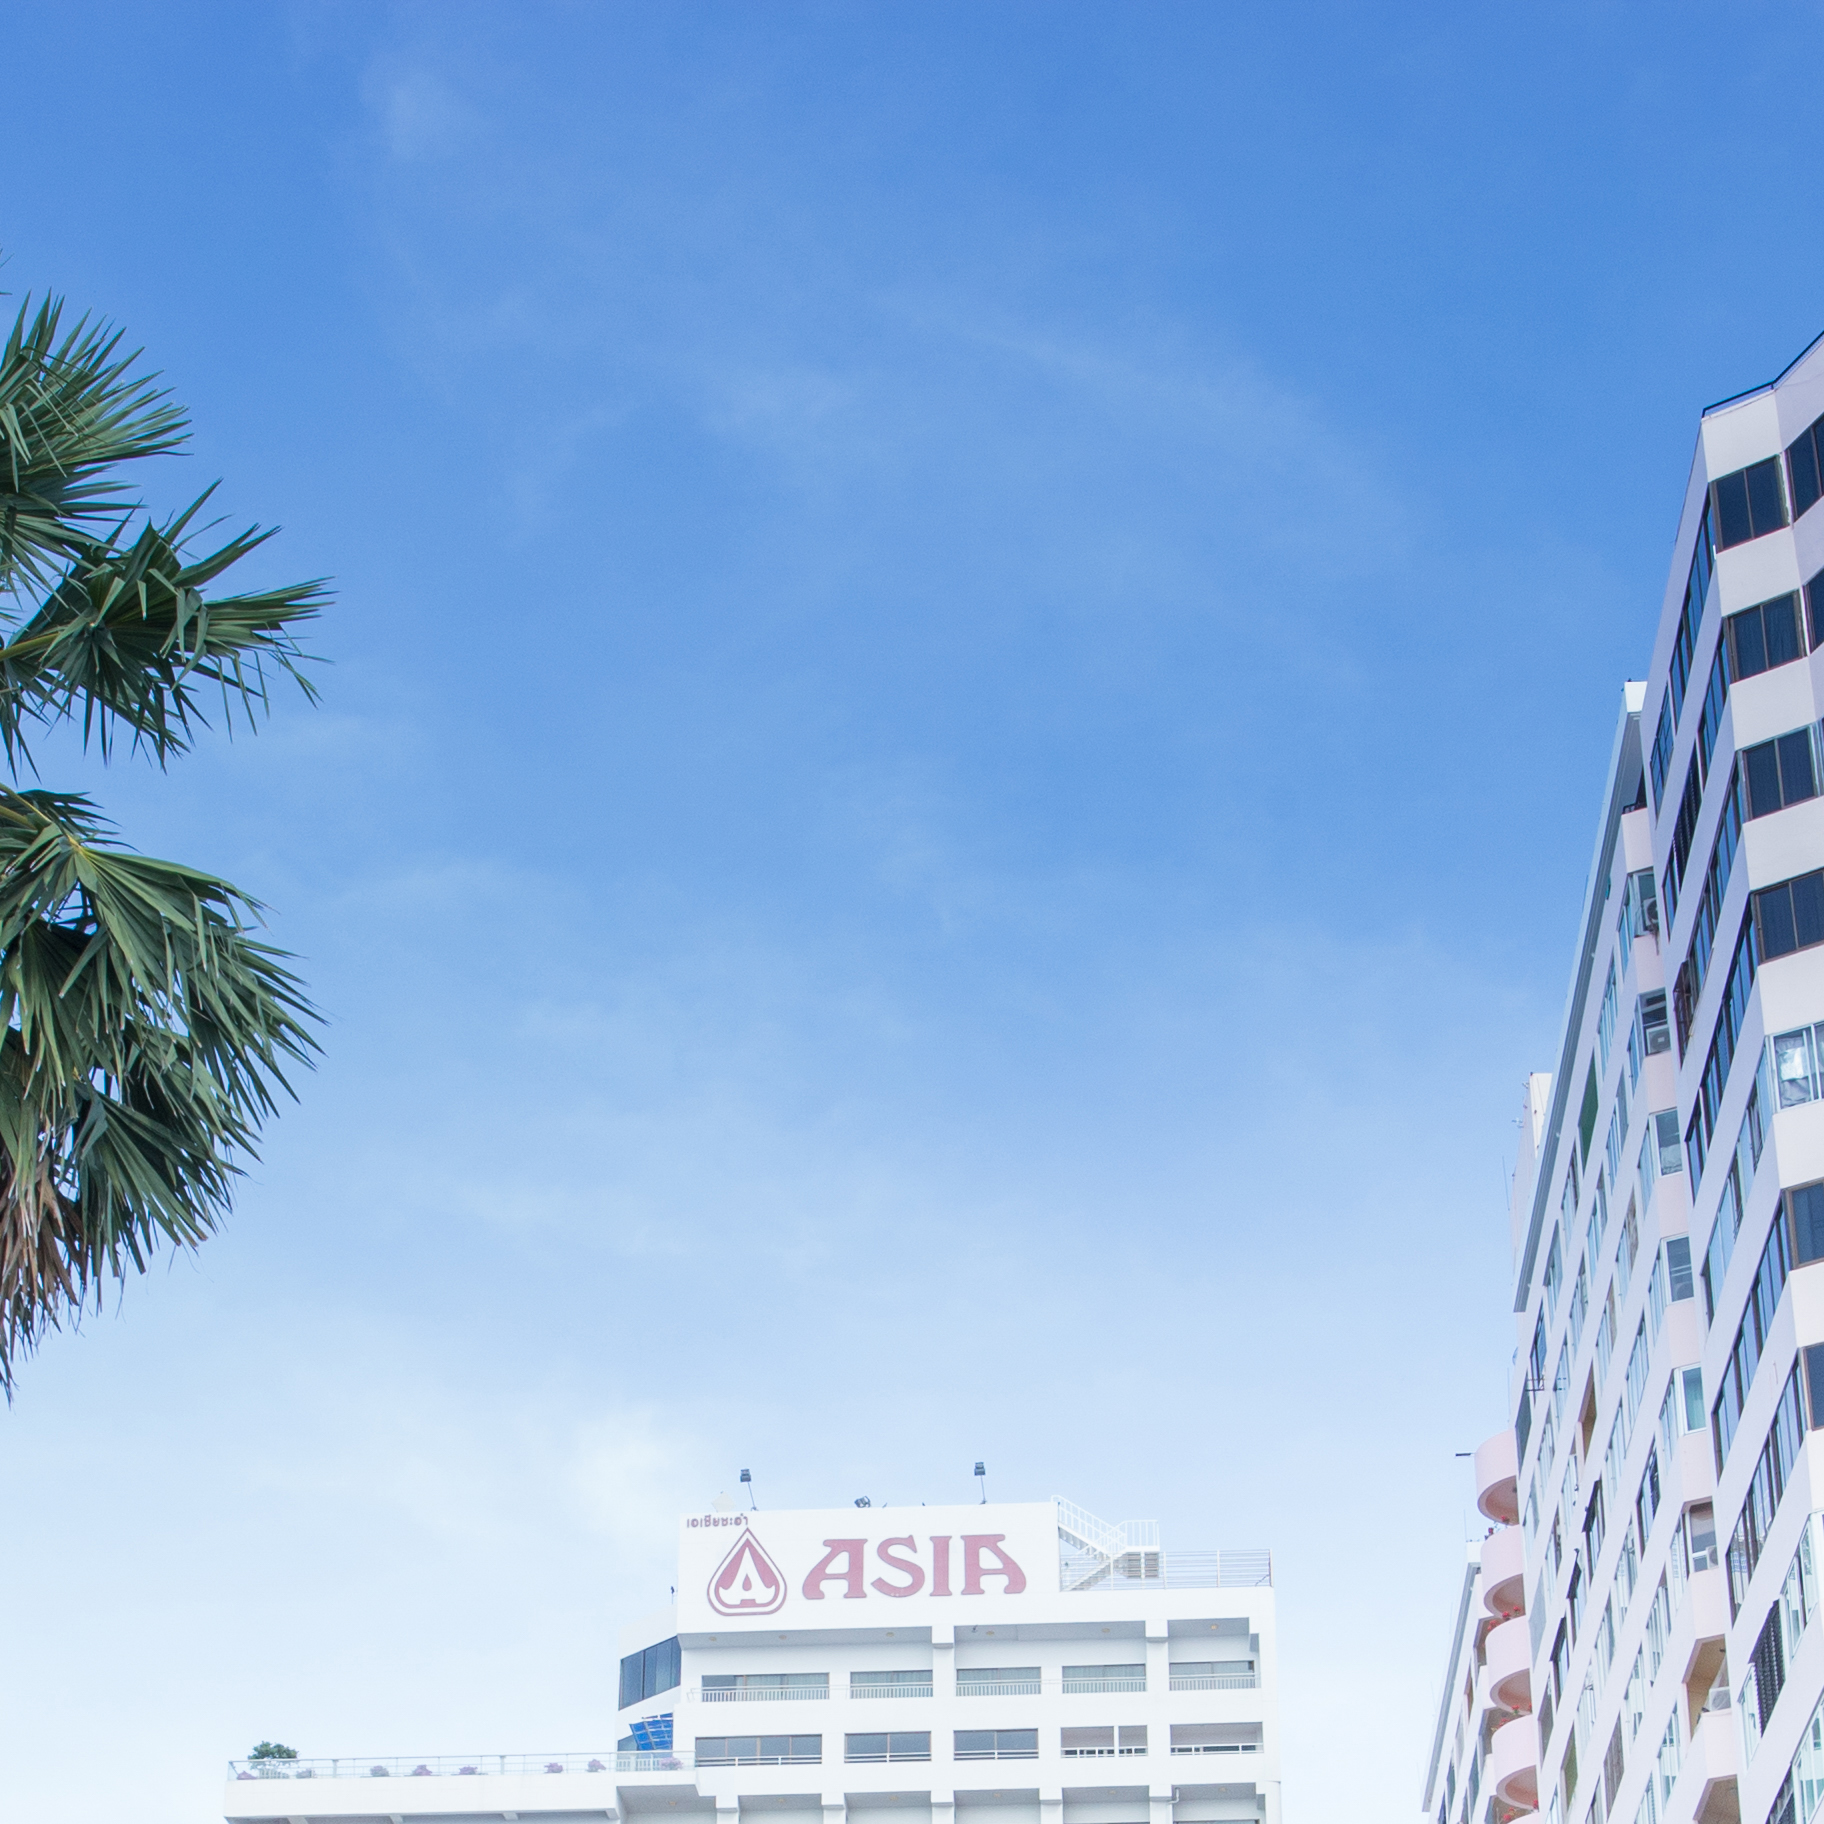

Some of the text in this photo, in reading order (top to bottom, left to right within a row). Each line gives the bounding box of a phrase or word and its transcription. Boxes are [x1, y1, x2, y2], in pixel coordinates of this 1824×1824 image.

[687, 1513, 748, 1528] เอเชียชะอำ
[802, 1534, 1026, 1600] ASIA
